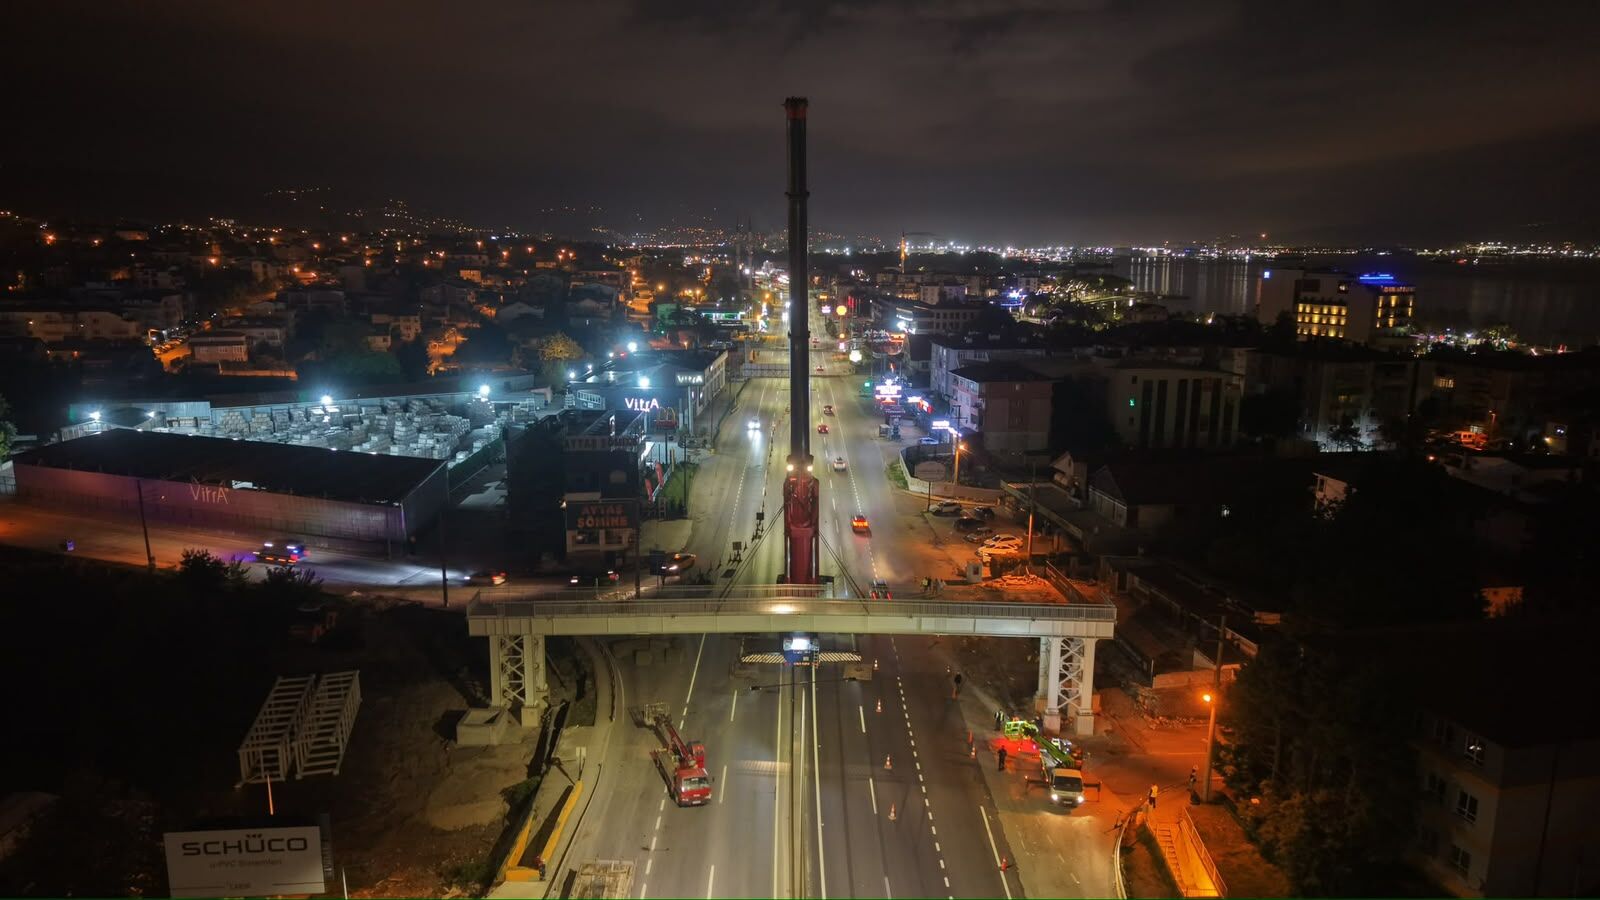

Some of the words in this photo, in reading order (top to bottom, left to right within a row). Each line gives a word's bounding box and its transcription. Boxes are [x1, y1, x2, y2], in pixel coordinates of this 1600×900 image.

[624, 397, 660, 412] VitrA
[188, 483, 229, 505] VitrA
[181, 833, 308, 856] SCHÜCO
